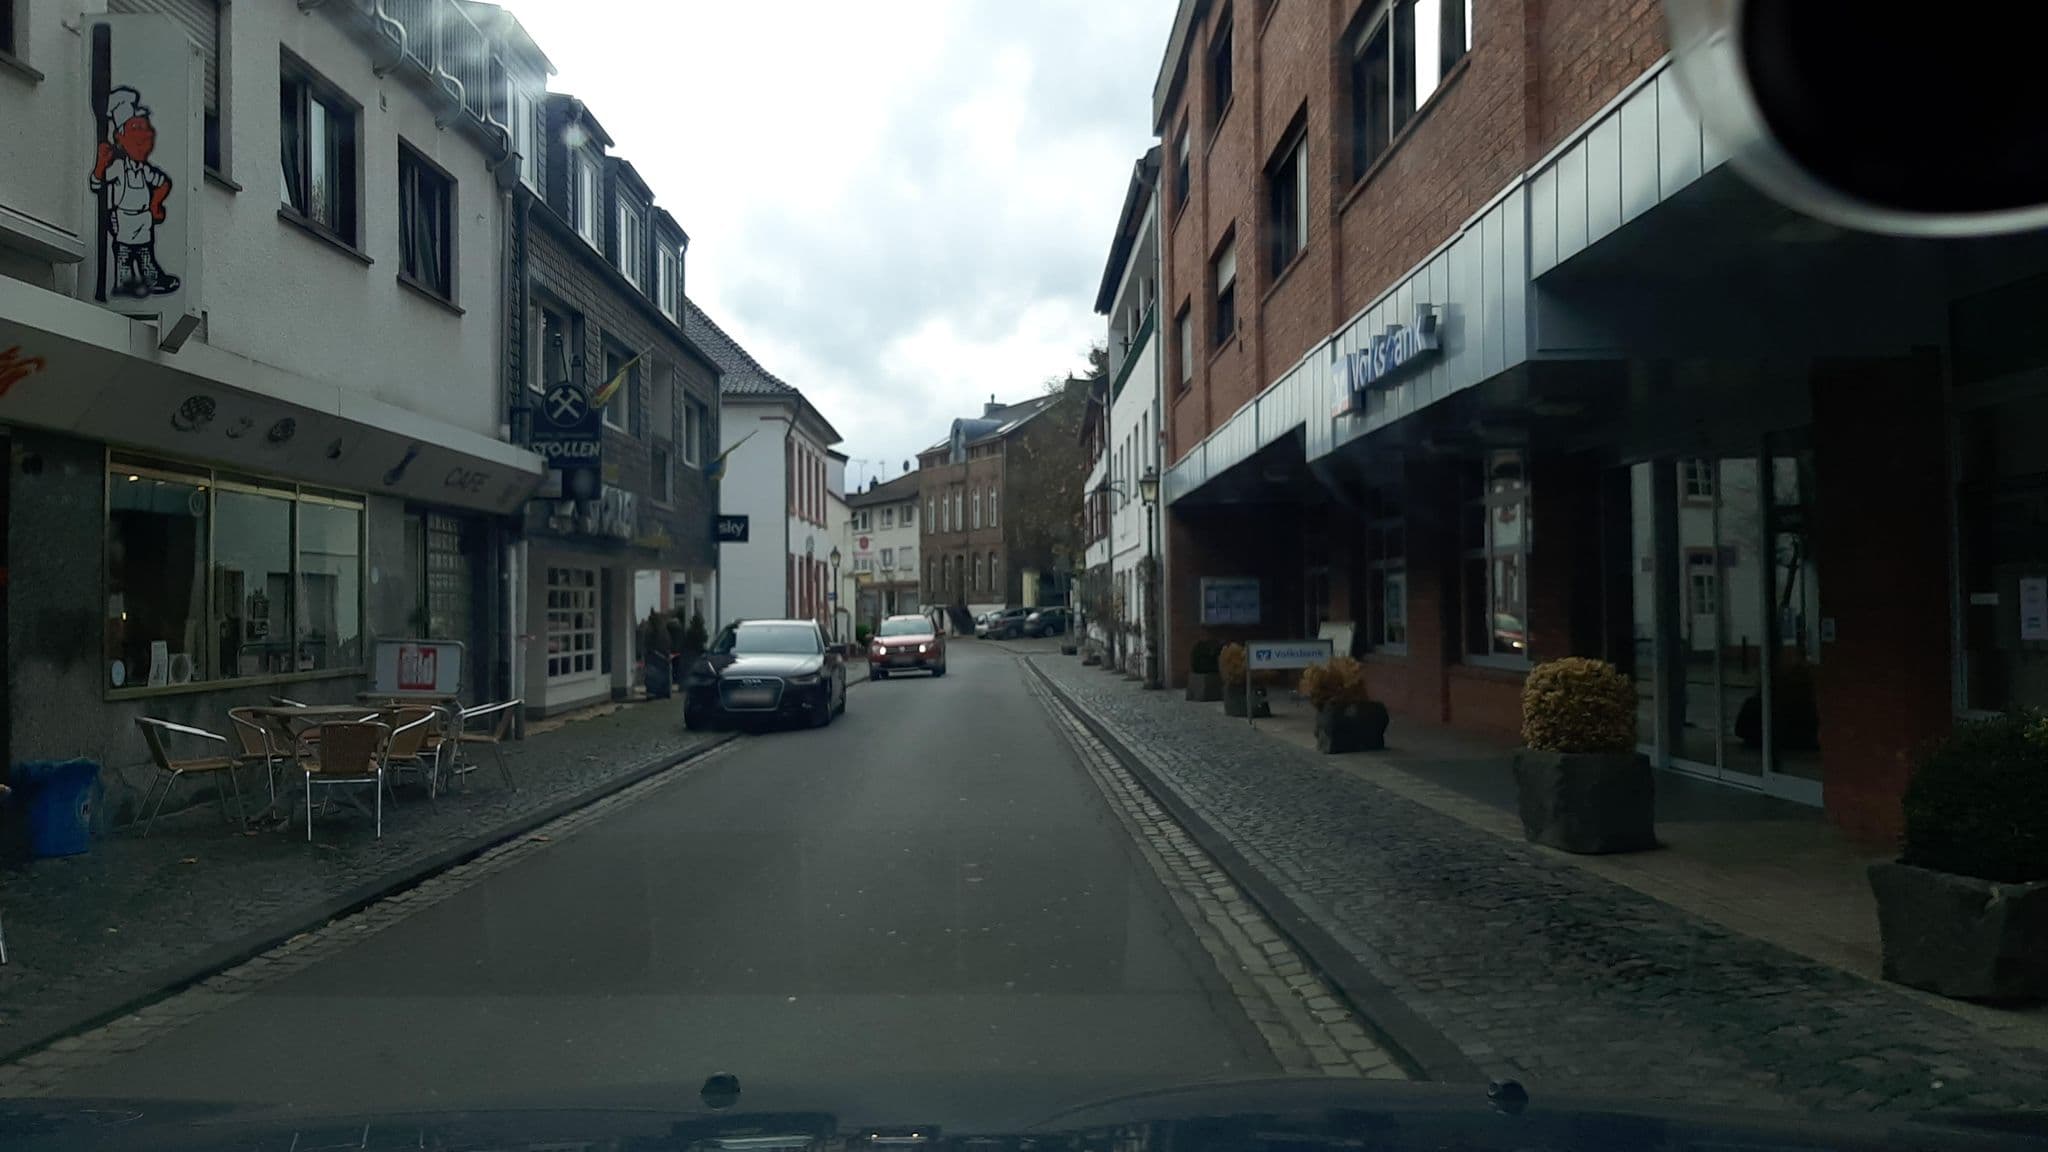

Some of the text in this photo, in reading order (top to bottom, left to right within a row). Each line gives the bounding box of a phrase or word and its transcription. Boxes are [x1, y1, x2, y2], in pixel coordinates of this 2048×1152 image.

[1348, 310, 1438, 392] Volksbank
[532, 440, 601, 458] STOLLEN
[718, 519, 746, 538] sky
[1274, 647, 1324, 660] Volksbank
